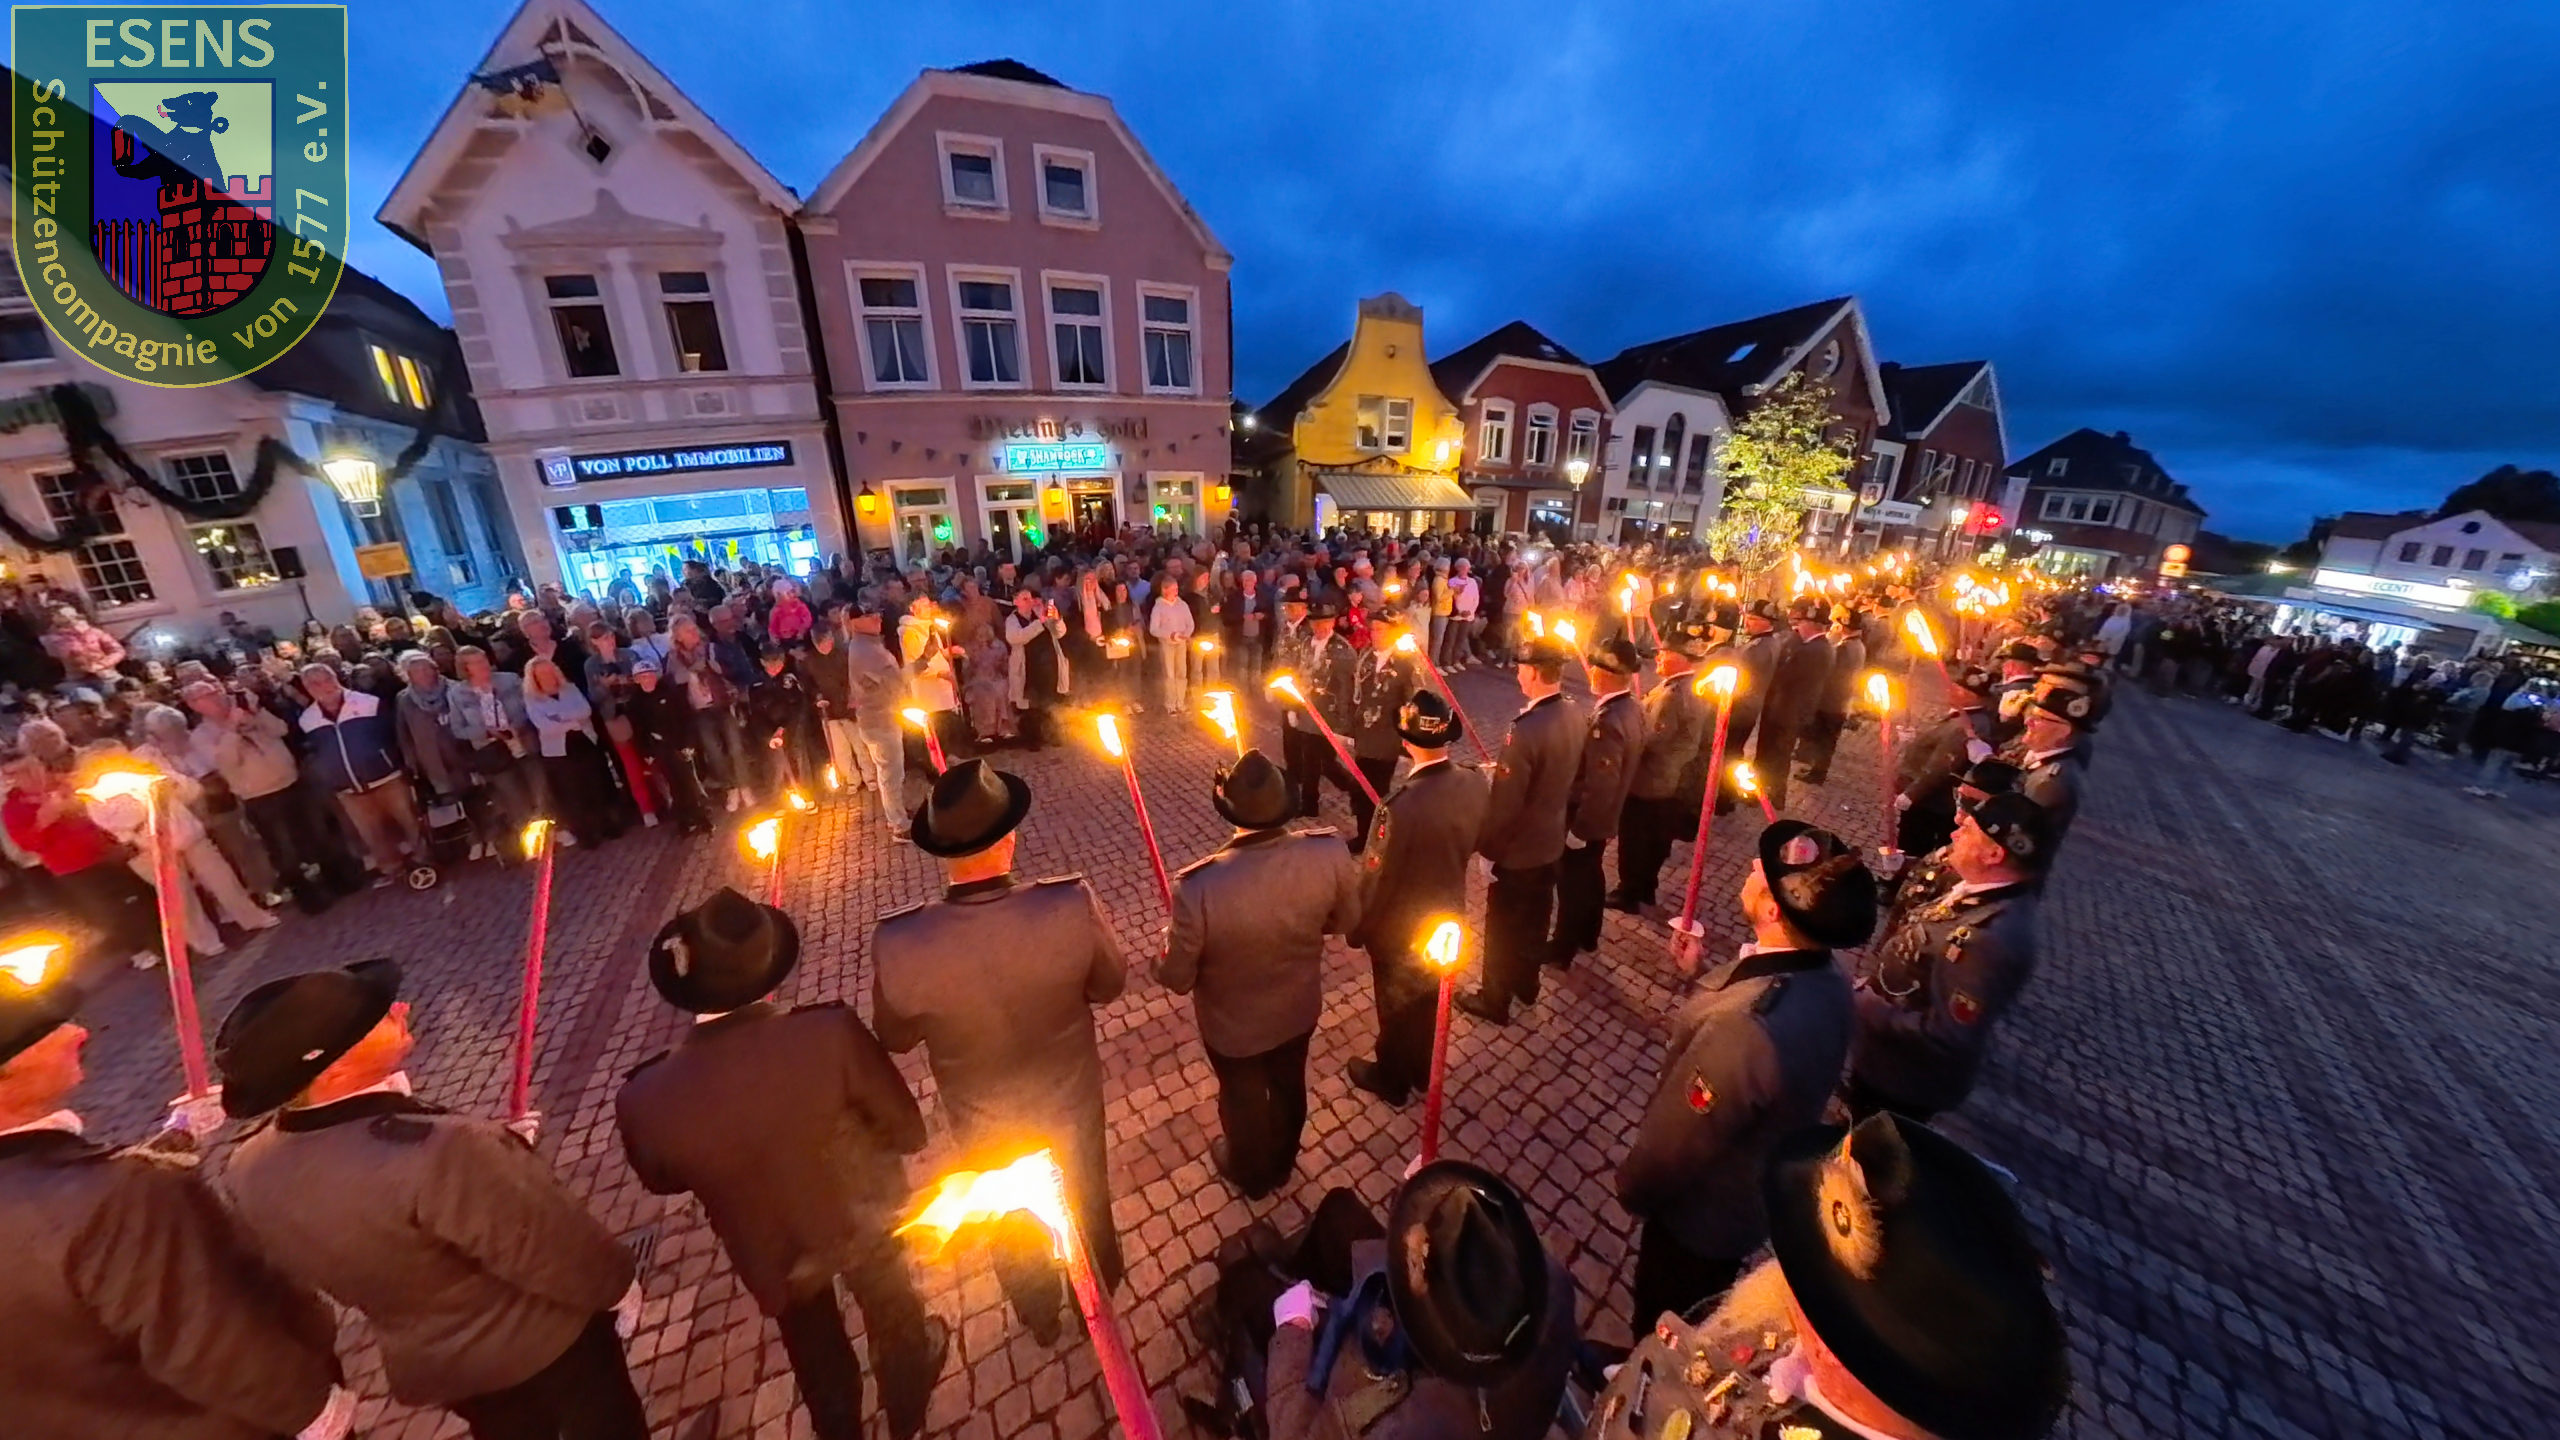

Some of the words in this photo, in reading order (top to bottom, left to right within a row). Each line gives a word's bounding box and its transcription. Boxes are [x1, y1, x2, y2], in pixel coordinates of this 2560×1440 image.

[579, 458, 622, 475] VON
[623, 453, 672, 471] POLL
[674, 446, 785, 467] IMMOBILIEN
[1029, 448, 1085, 464] SHAMROCK
